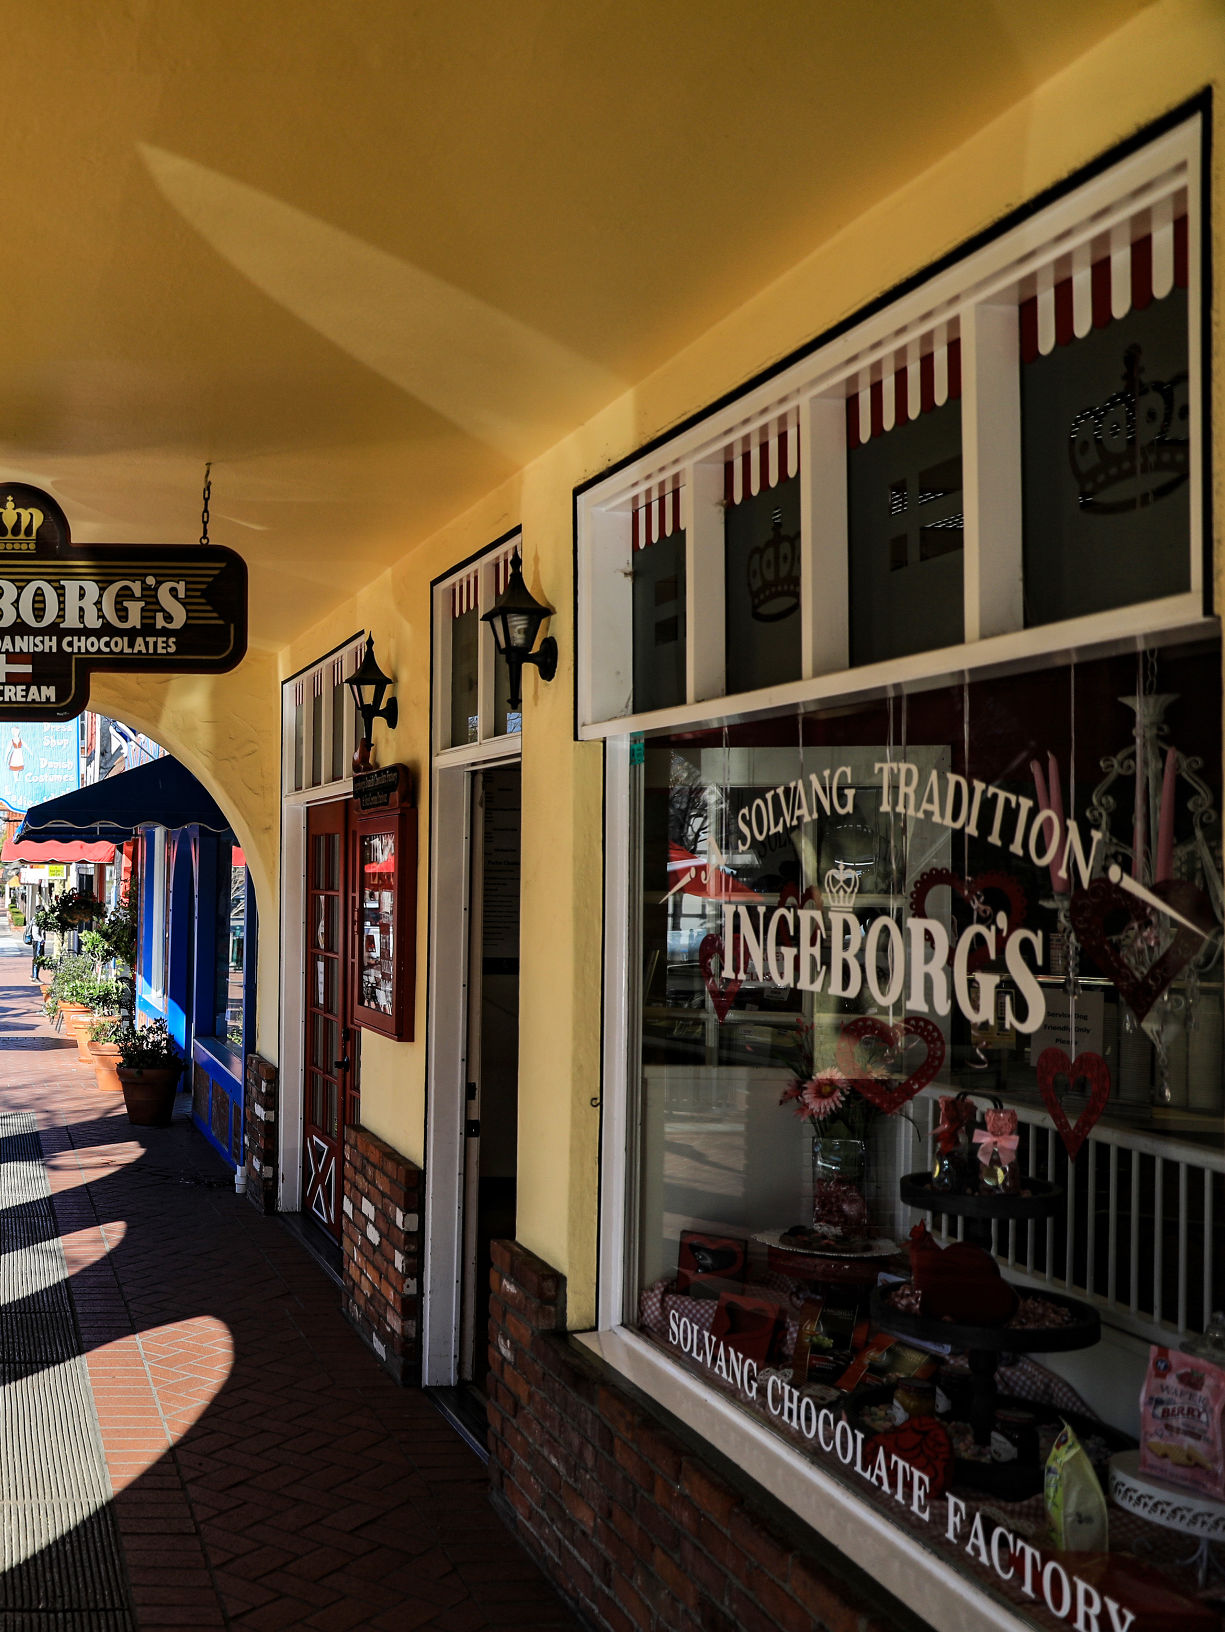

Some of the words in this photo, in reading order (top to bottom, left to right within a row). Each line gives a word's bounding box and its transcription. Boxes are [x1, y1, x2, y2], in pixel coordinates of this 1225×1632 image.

[62, 636, 176, 654] CHOCOLATES
[24, 772, 75, 784] Costumes
[43, 735, 69, 749] Shop
[737, 765, 856, 853] SOLVANG
[874, 761, 1103, 890] TRADITION
[721, 903, 1046, 1035] INGEBORG'S
[668, 1309, 758, 1400] SOLVANG
[766, 1374, 930, 1523] CHOCOLATE
[944, 1491, 1137, 1632] FACTORY
